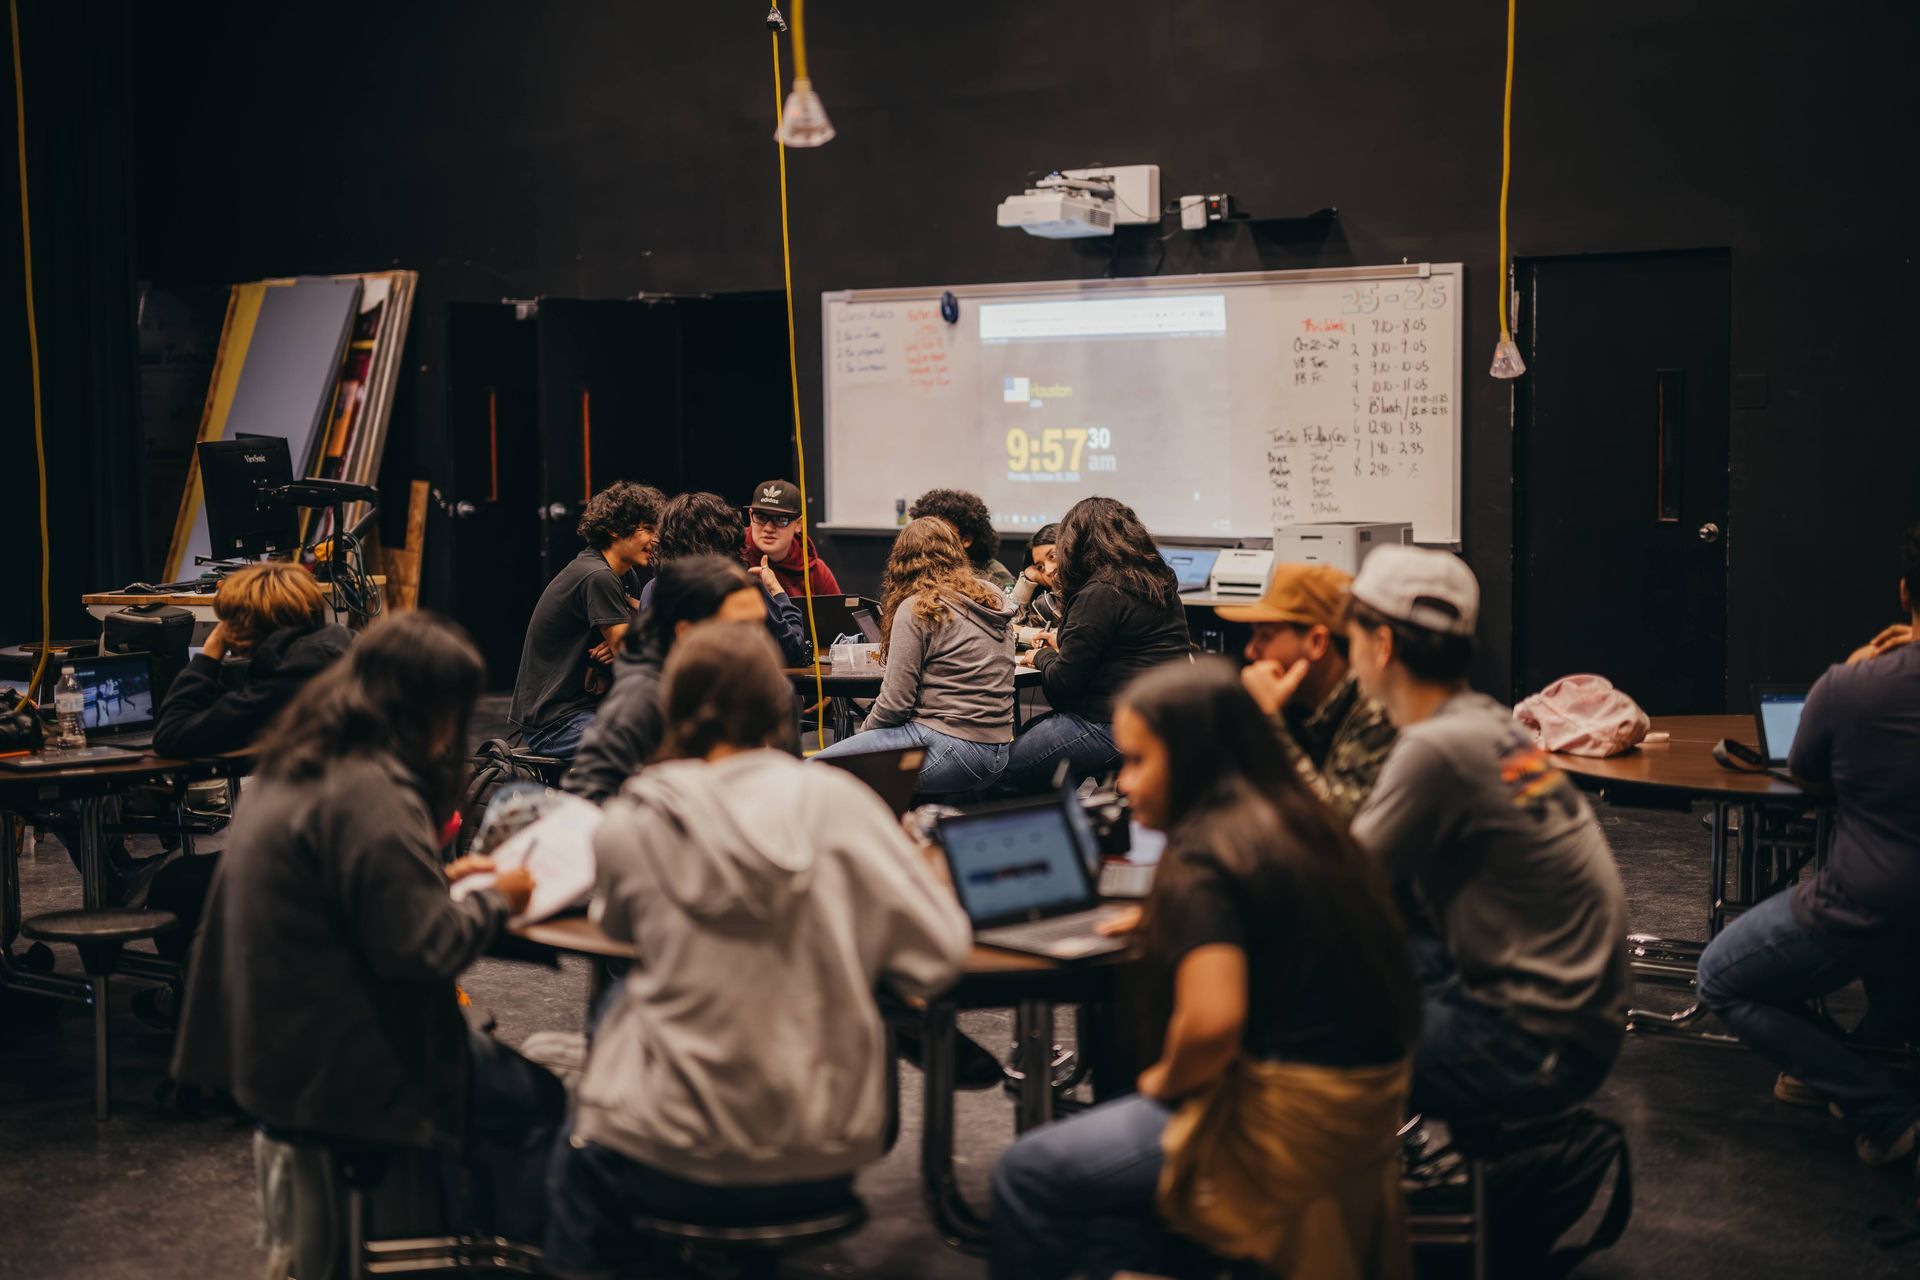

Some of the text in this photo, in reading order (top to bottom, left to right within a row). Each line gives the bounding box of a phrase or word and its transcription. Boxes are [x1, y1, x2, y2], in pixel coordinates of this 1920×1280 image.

[1005, 426, 1111, 472] 9:57 30
[1087, 454, 1117, 472] am
[760, 497, 779, 505] adidas
